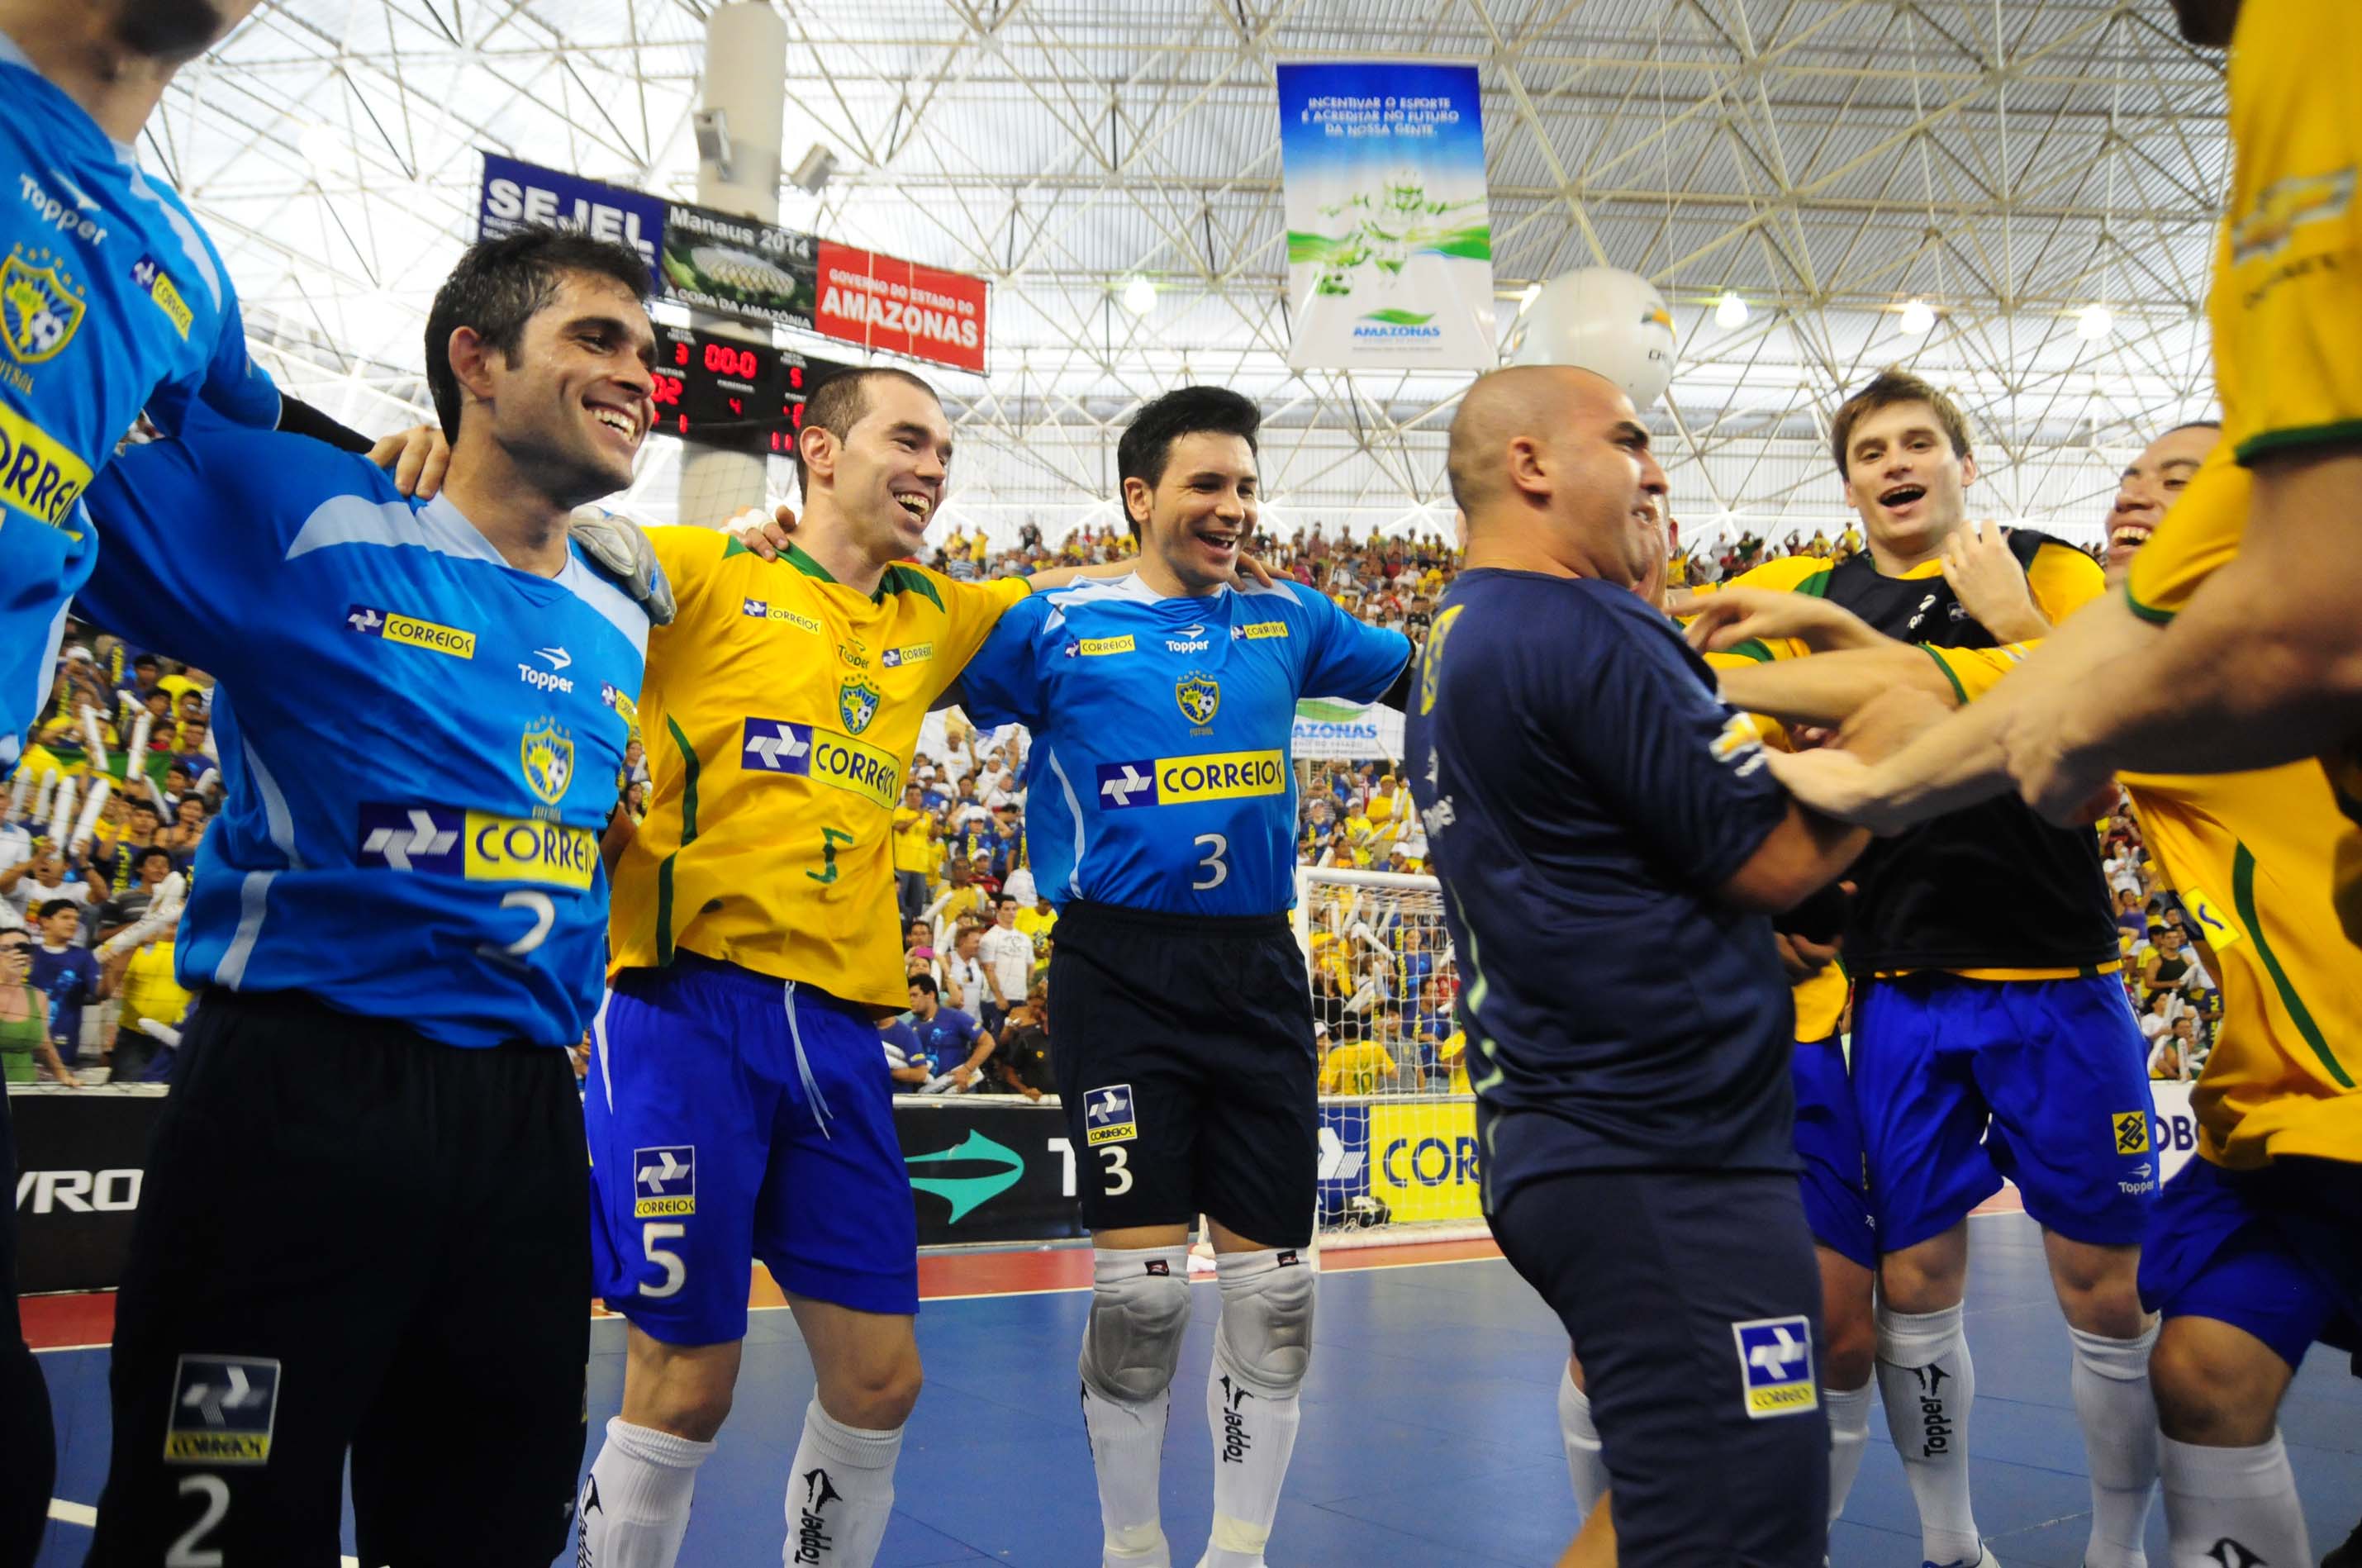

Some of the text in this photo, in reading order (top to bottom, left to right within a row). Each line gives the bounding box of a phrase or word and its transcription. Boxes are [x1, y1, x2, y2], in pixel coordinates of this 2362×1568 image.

[21, 173, 107, 245] Topper
[670, 205, 810, 259] Manaus 2014
[829, 268, 889, 296] GOVERNO
[820, 285, 979, 349] AMAZONAS
[1352, 326, 1440, 337] AMAZONAS
[388, 620, 472, 653] CORREIOS
[768, 608, 820, 634] CORREIOS
[1082, 639, 1133, 653] CORREIOS
[1166, 640, 1210, 653] Topper
[518, 663, 573, 693] Topper
[1163, 759, 1282, 793] CORREIOS
[1192, 833, 1229, 890] 3
[1090, 1126, 1133, 1142] CORREIOS
[1099, 1145, 1133, 1196] 3
[636, 1200, 695, 1214] CORREIOS
[639, 1222, 687, 1297] 5
[1224, 1406, 1251, 1463] Topper
[1919, 1395, 1952, 1458] Topper
[165, 1473, 230, 1568] 2
[794, 1506, 832, 1566] Topper
